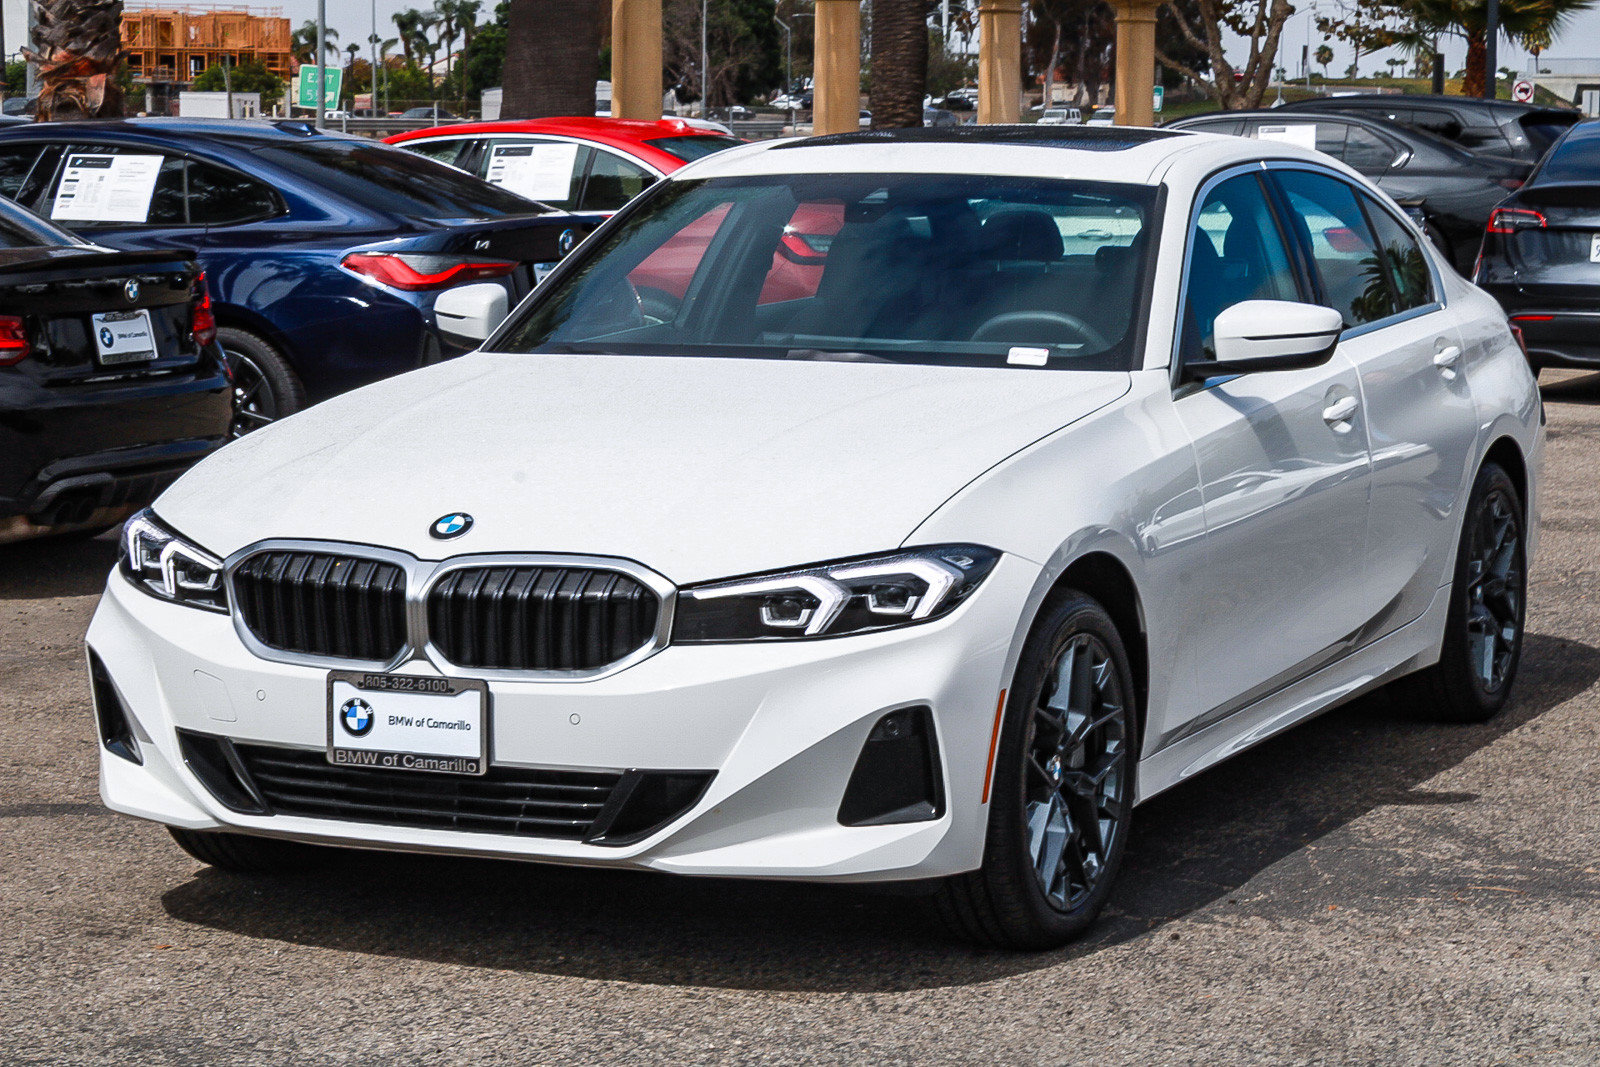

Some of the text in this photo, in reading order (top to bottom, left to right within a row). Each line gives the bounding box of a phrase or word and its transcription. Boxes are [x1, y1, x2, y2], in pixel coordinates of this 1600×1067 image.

[365, 676, 447, 692] 805-322-6100
[388, 715, 471, 731] BMW of Camarillo
[336, 750, 477, 772] BMW of Camarillo
